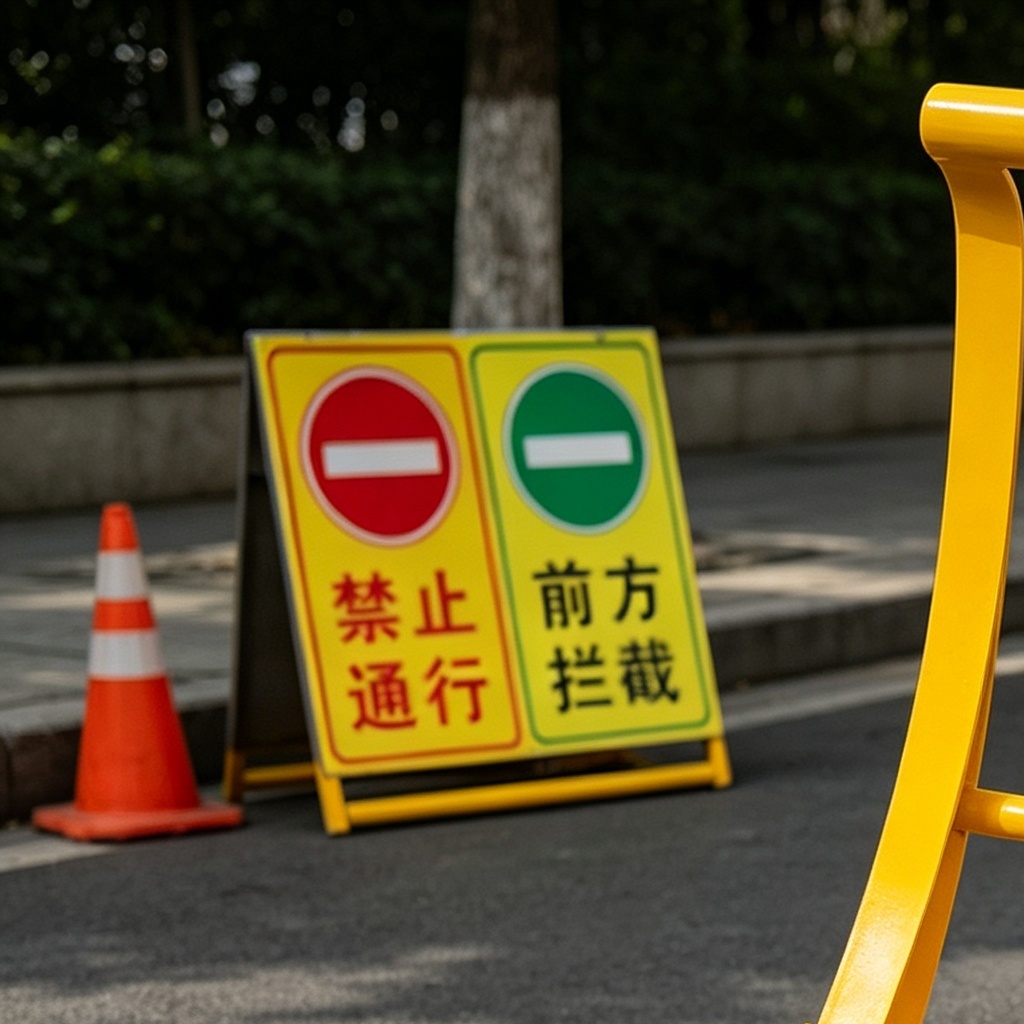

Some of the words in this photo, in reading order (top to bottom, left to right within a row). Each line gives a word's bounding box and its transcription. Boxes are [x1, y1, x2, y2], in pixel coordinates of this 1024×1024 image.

[333, 569, 477, 643] 禁止
[533, 556, 660, 630] 前方
[348, 657, 488, 731] 通行
[548, 638, 680, 714] 拦截
